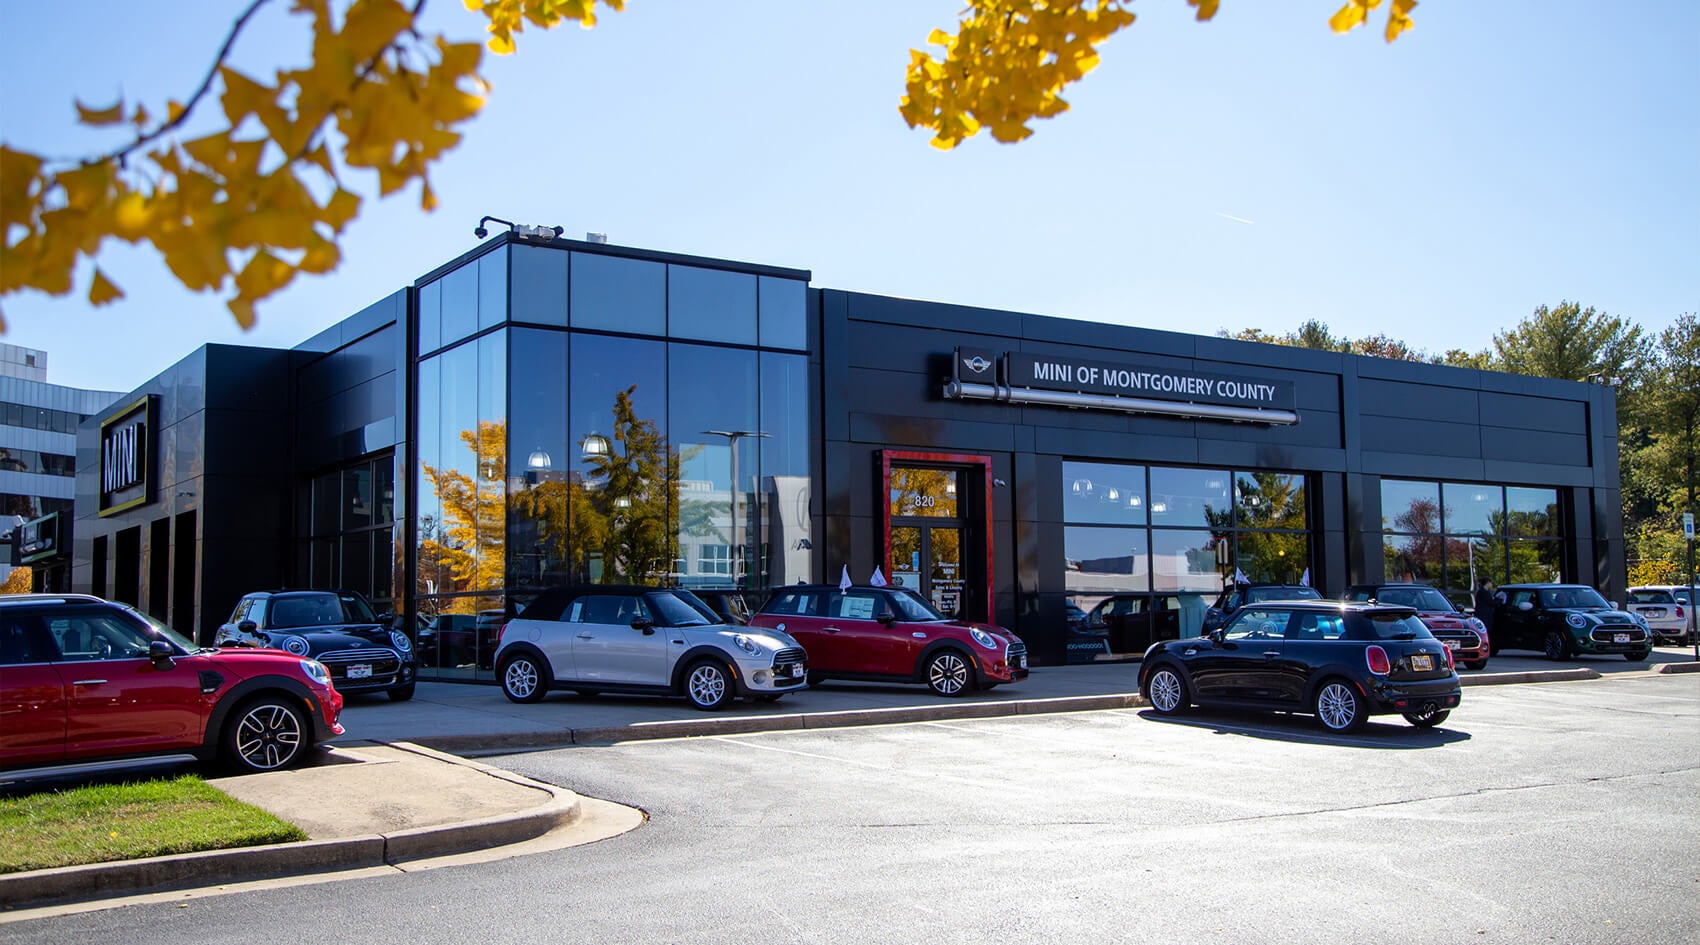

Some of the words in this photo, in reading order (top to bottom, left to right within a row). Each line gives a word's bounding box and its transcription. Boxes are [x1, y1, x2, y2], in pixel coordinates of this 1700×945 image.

[1033, 361, 1072, 383] MINI
[1076, 366, 1099, 385] OF
[1103, 369, 1214, 396] MONTGOMERY
[1216, 380, 1276, 401] COUNTY
[104, 423, 137, 494] MINI
[914, 495, 935, 507] 820
